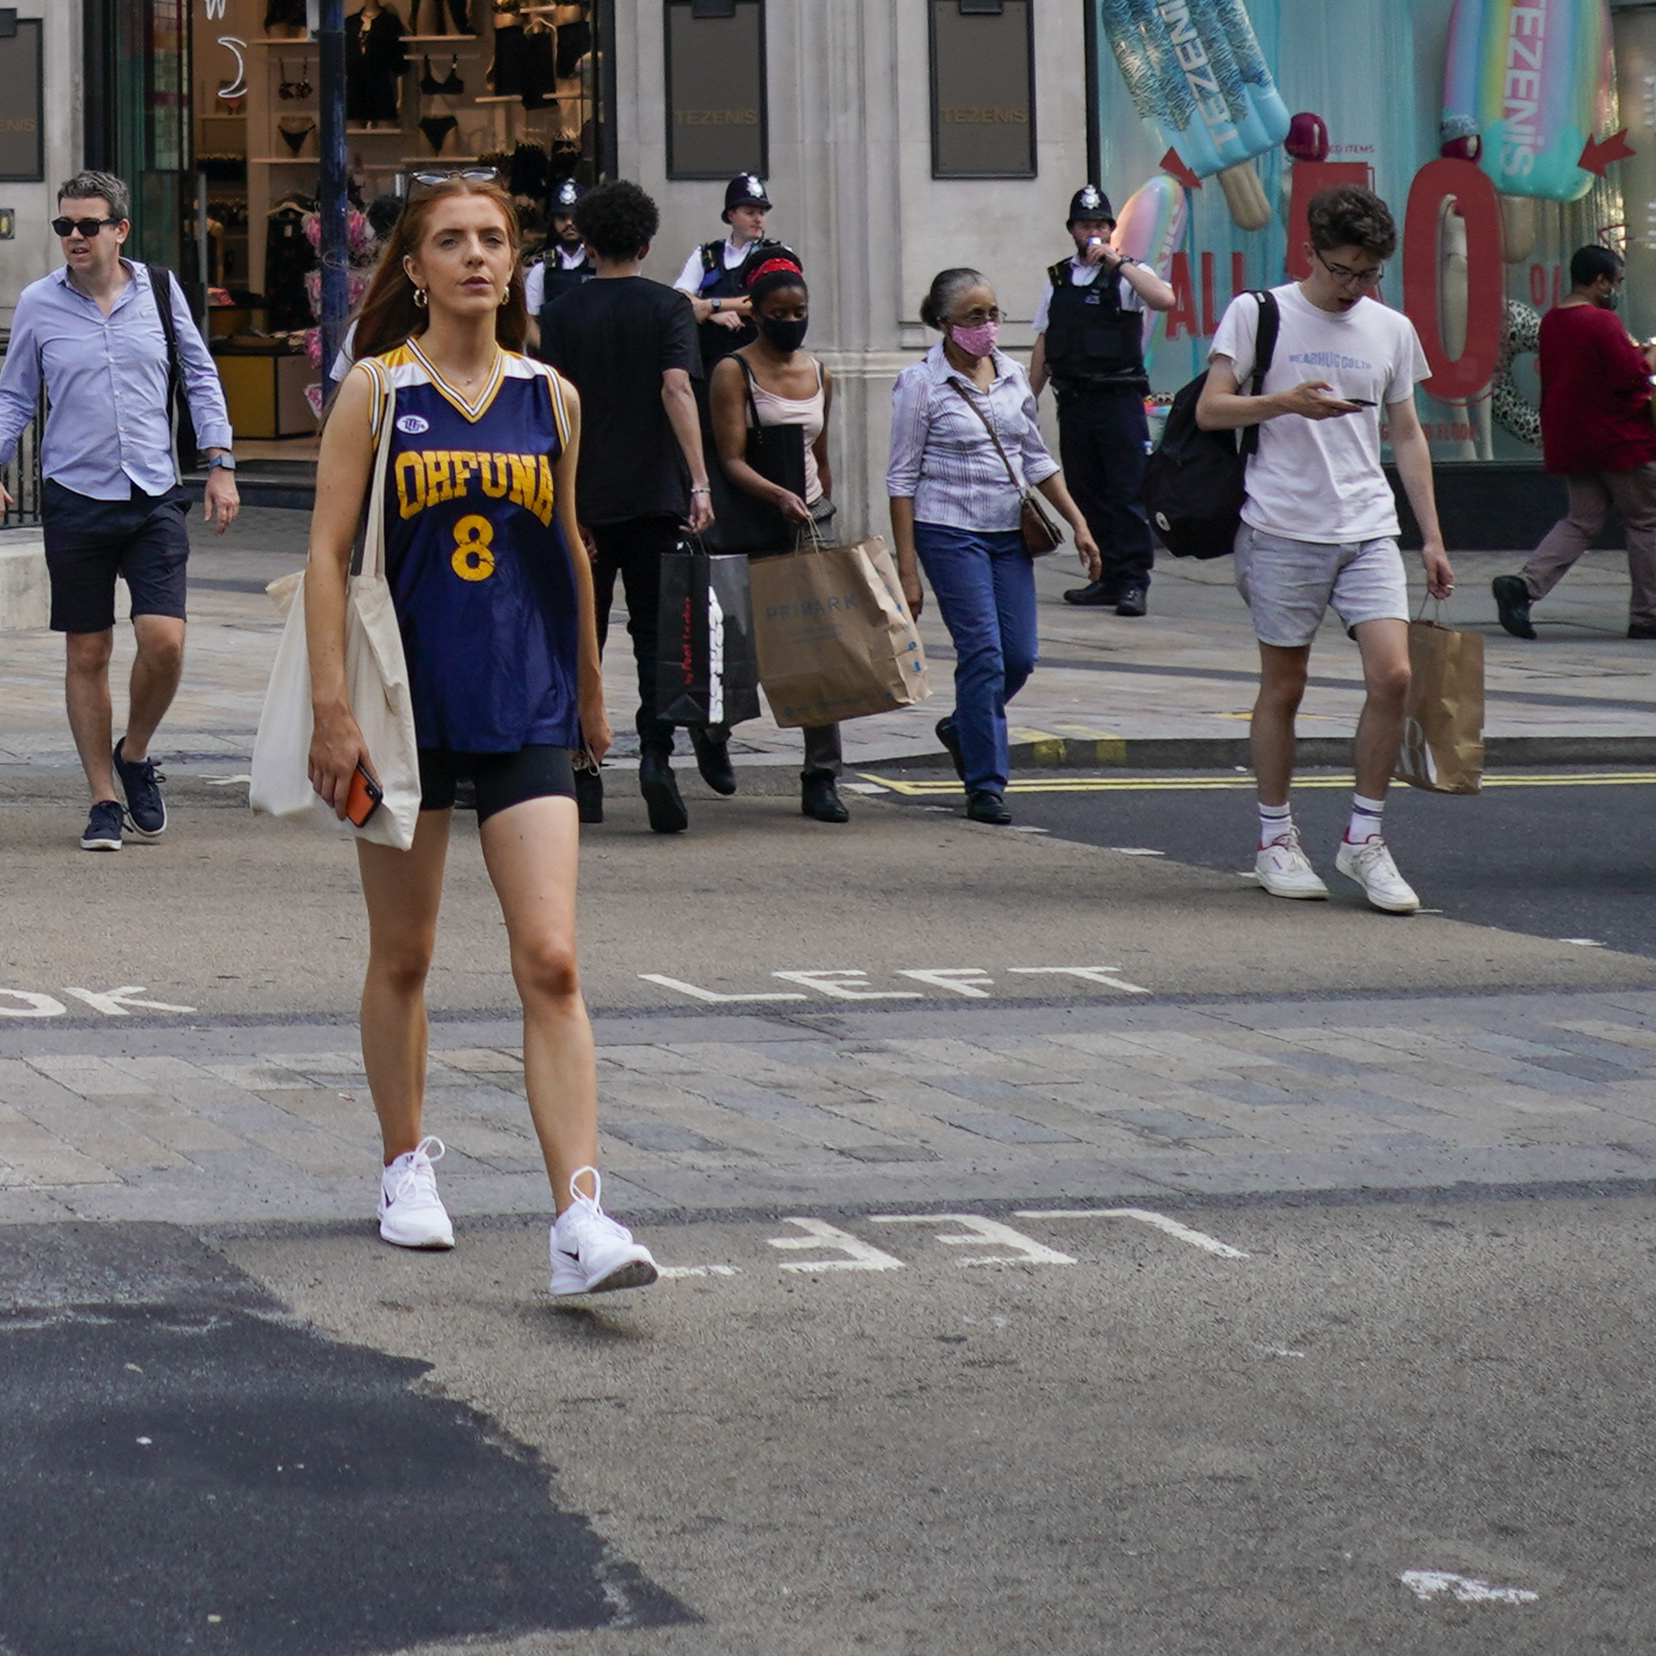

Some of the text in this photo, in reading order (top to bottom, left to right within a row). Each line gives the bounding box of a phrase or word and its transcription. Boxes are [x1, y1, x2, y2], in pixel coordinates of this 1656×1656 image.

[451, 514, 496, 582] 8
[763, 592, 859, 622] PRIMARK
[636, 965, 1152, 1003] LEFT
